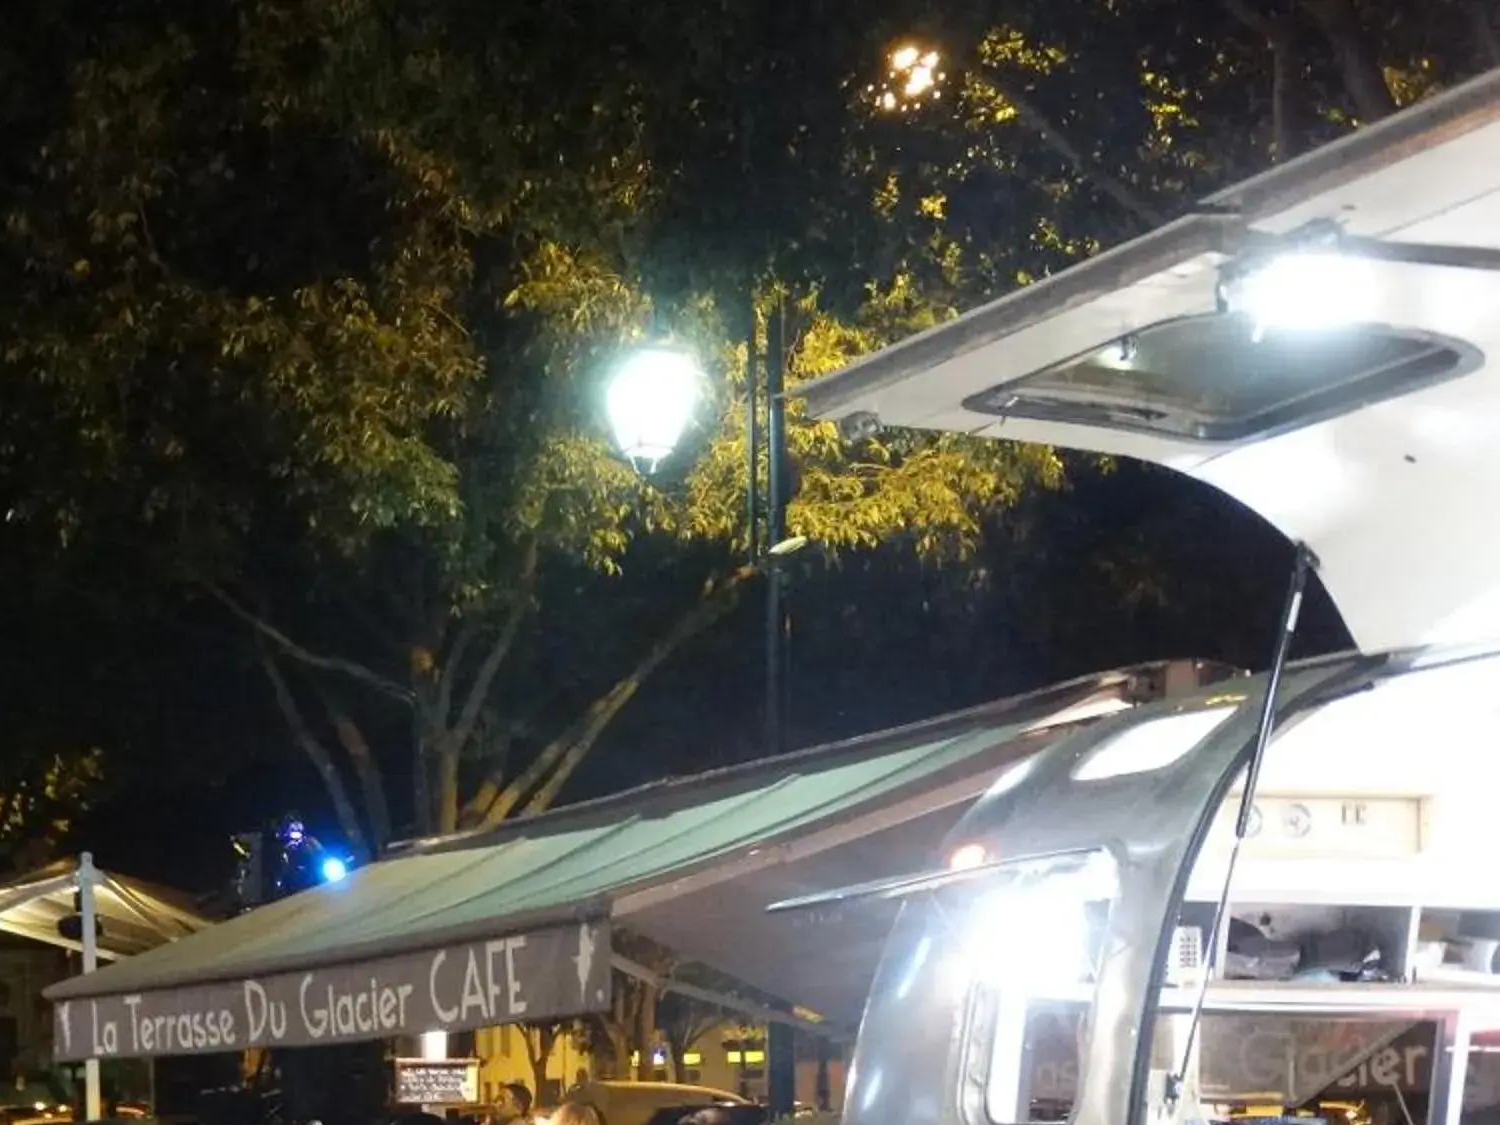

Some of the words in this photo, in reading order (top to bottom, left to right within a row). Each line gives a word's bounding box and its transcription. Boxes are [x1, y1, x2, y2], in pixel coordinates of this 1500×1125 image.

[92, 1002, 118, 1057] La
[124, 994, 237, 1051] Terrasse
[244, 978, 288, 1042] Du
[299, 972, 414, 1039] Glacier
